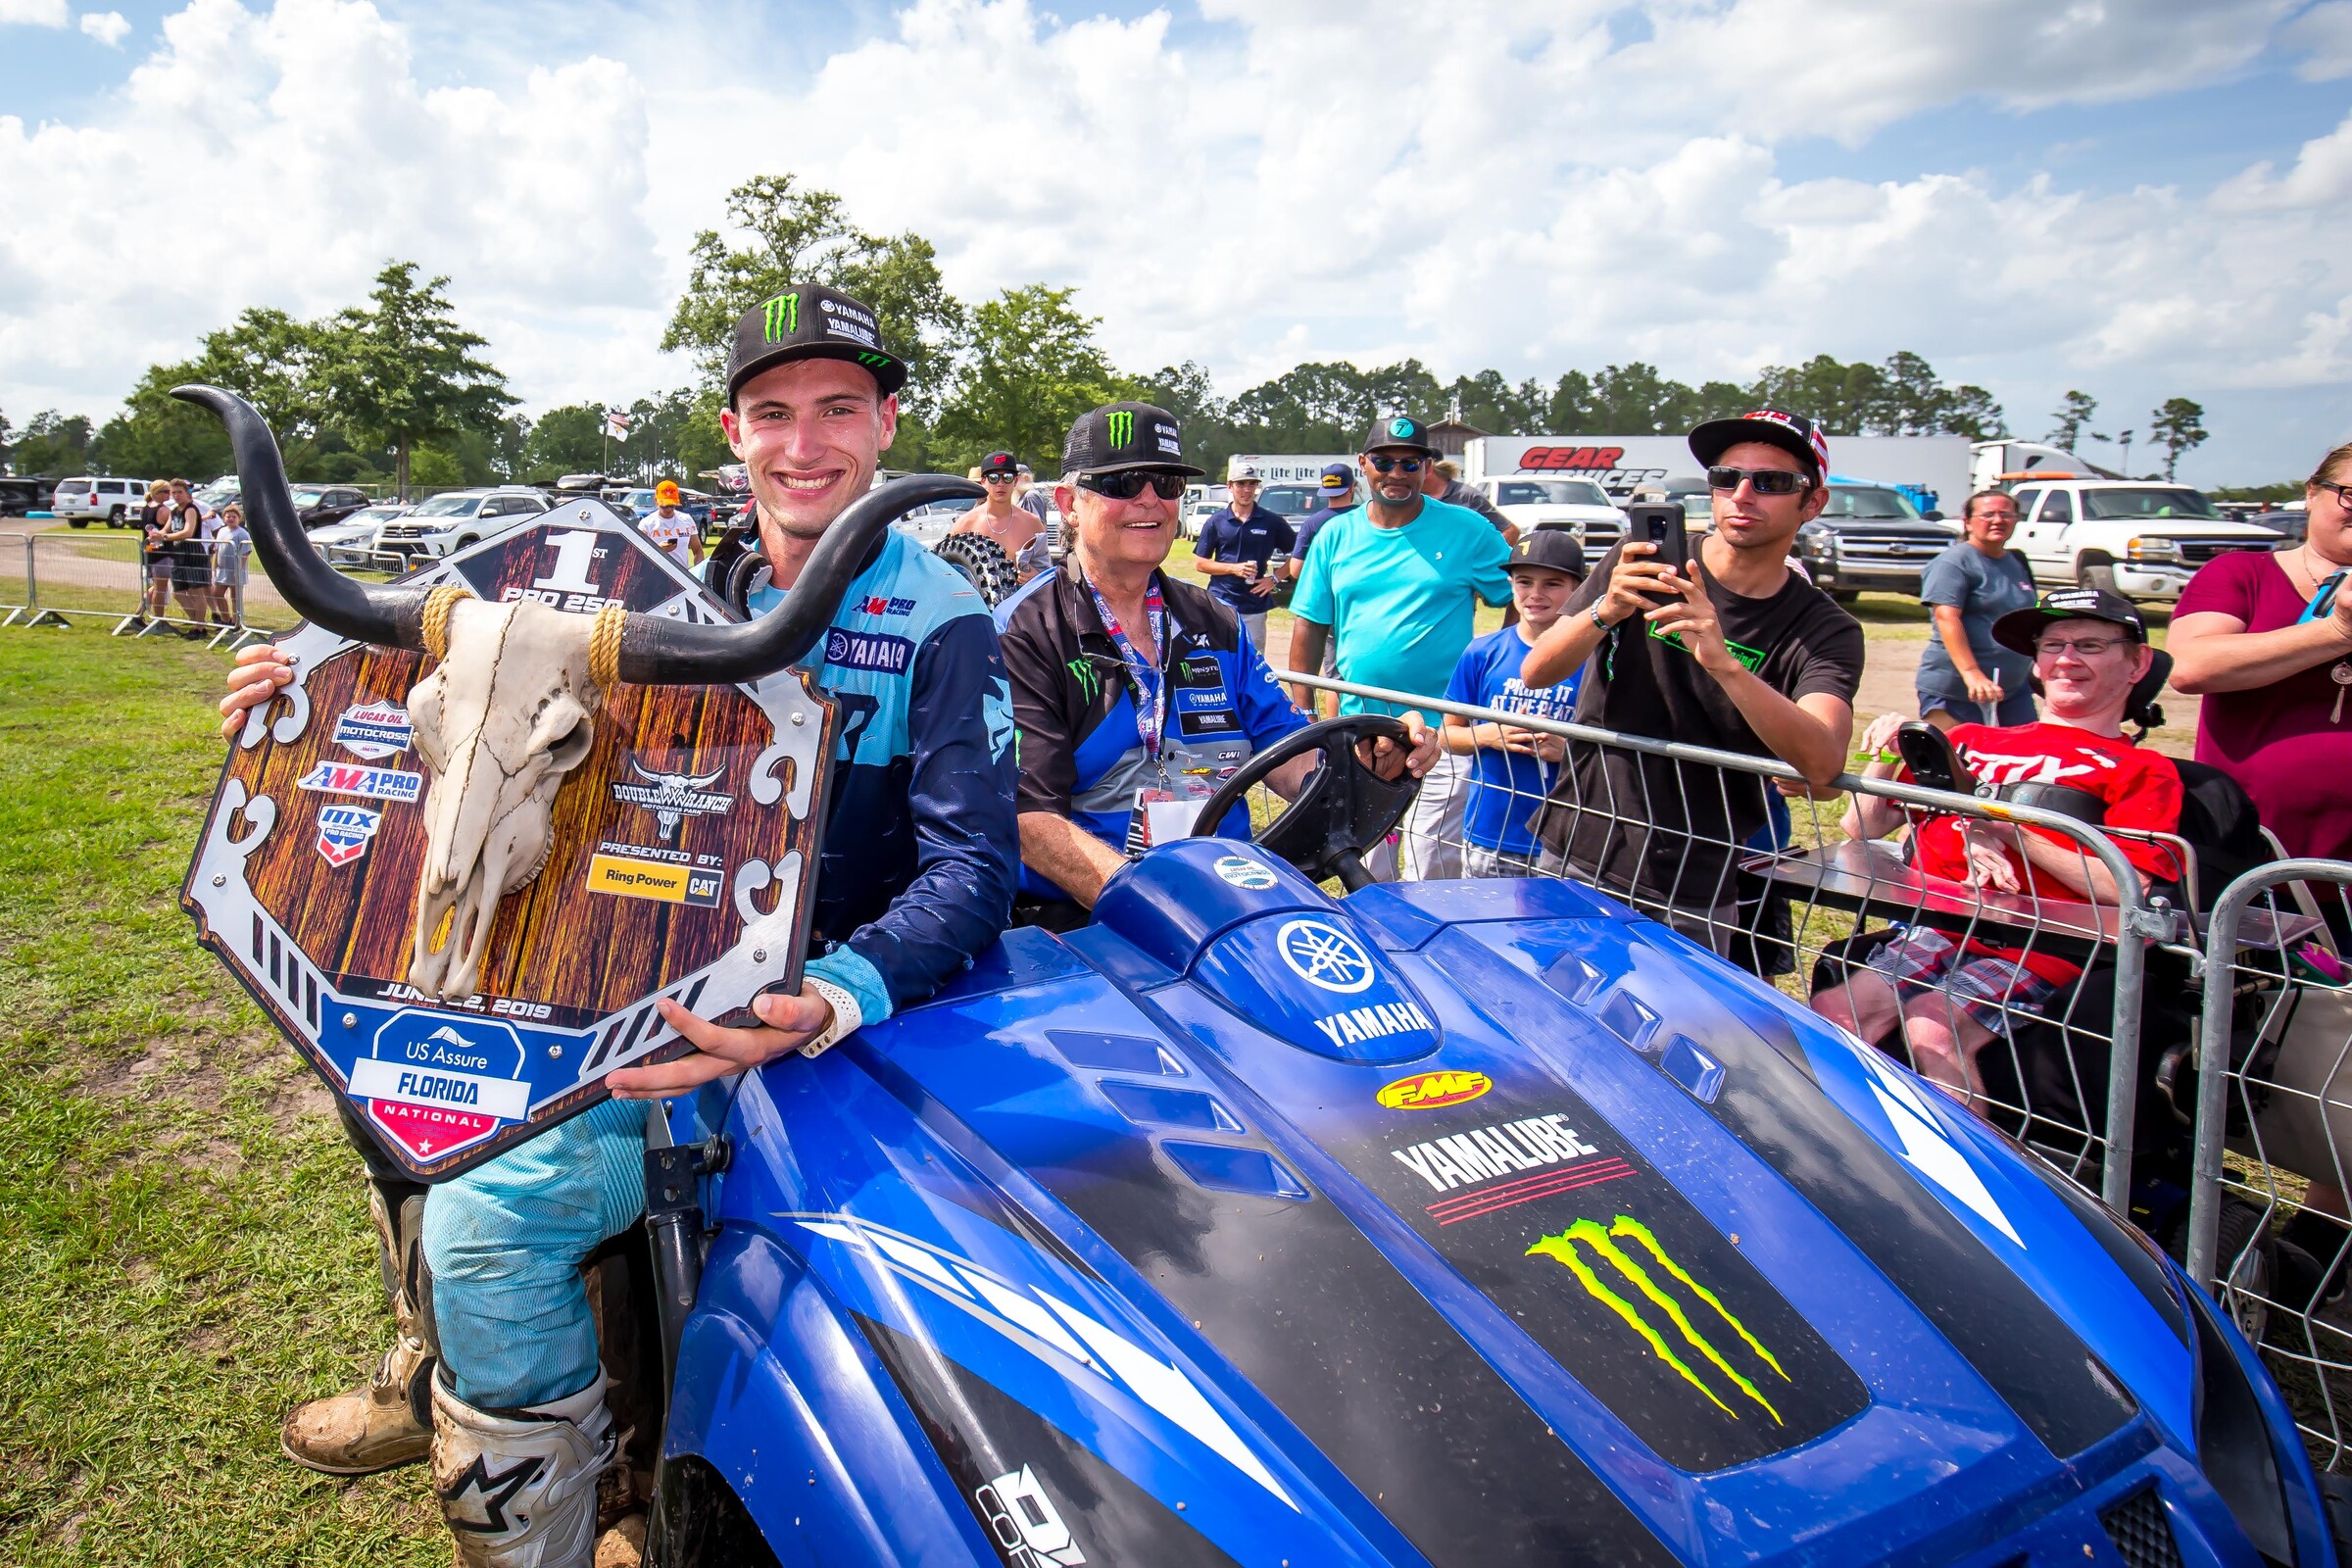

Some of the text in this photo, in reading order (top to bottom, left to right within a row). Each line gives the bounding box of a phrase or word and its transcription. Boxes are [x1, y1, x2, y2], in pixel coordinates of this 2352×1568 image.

[835, 303, 875, 330] YAMAHA
[1519, 446, 1625, 468] GEAR
[1271, 466, 1291, 481] Lite
[1296, 466, 1315, 481] Lite
[592, 547, 609, 559] ST
[501, 587, 561, 608] PRO
[851, 595, 889, 615] AM
[888, 596, 917, 611] PRO
[886, 607, 911, 617] RACING
[1196, 692, 1227, 704] YAMAHA
[1503, 677, 1574, 704] PROVE IT
[353, 710, 404, 724] LUCAS OIL
[1491, 694, 1577, 722] AT THE PLAT
[339, 726, 410, 741] MOTOCROSS
[306, 766, 379, 793] AMA
[379, 773, 419, 791] PRO
[376, 787, 416, 799] RACING
[613, 784, 662, 804] DOUBLE
[686, 792, 733, 812] RANCH
[641, 804, 682, 812] MOTOCROSS
[325, 828, 366, 840] PRO RACING
[600, 842, 723, 867] PRESENTED BY:
[605, 868, 677, 890] Ring Power
[689, 877, 718, 898] CAT
[446, 995, 487, 1012] 2,
[492, 999, 553, 1019] 2019
[1313, 1001, 1434, 1048] YAMAHA
[406, 1041, 488, 1070] US Assure
[397, 1072, 478, 1105] FLORIDA
[1384, 1071, 1486, 1109] FMF
[383, 1104, 482, 1129] NATIONAL
